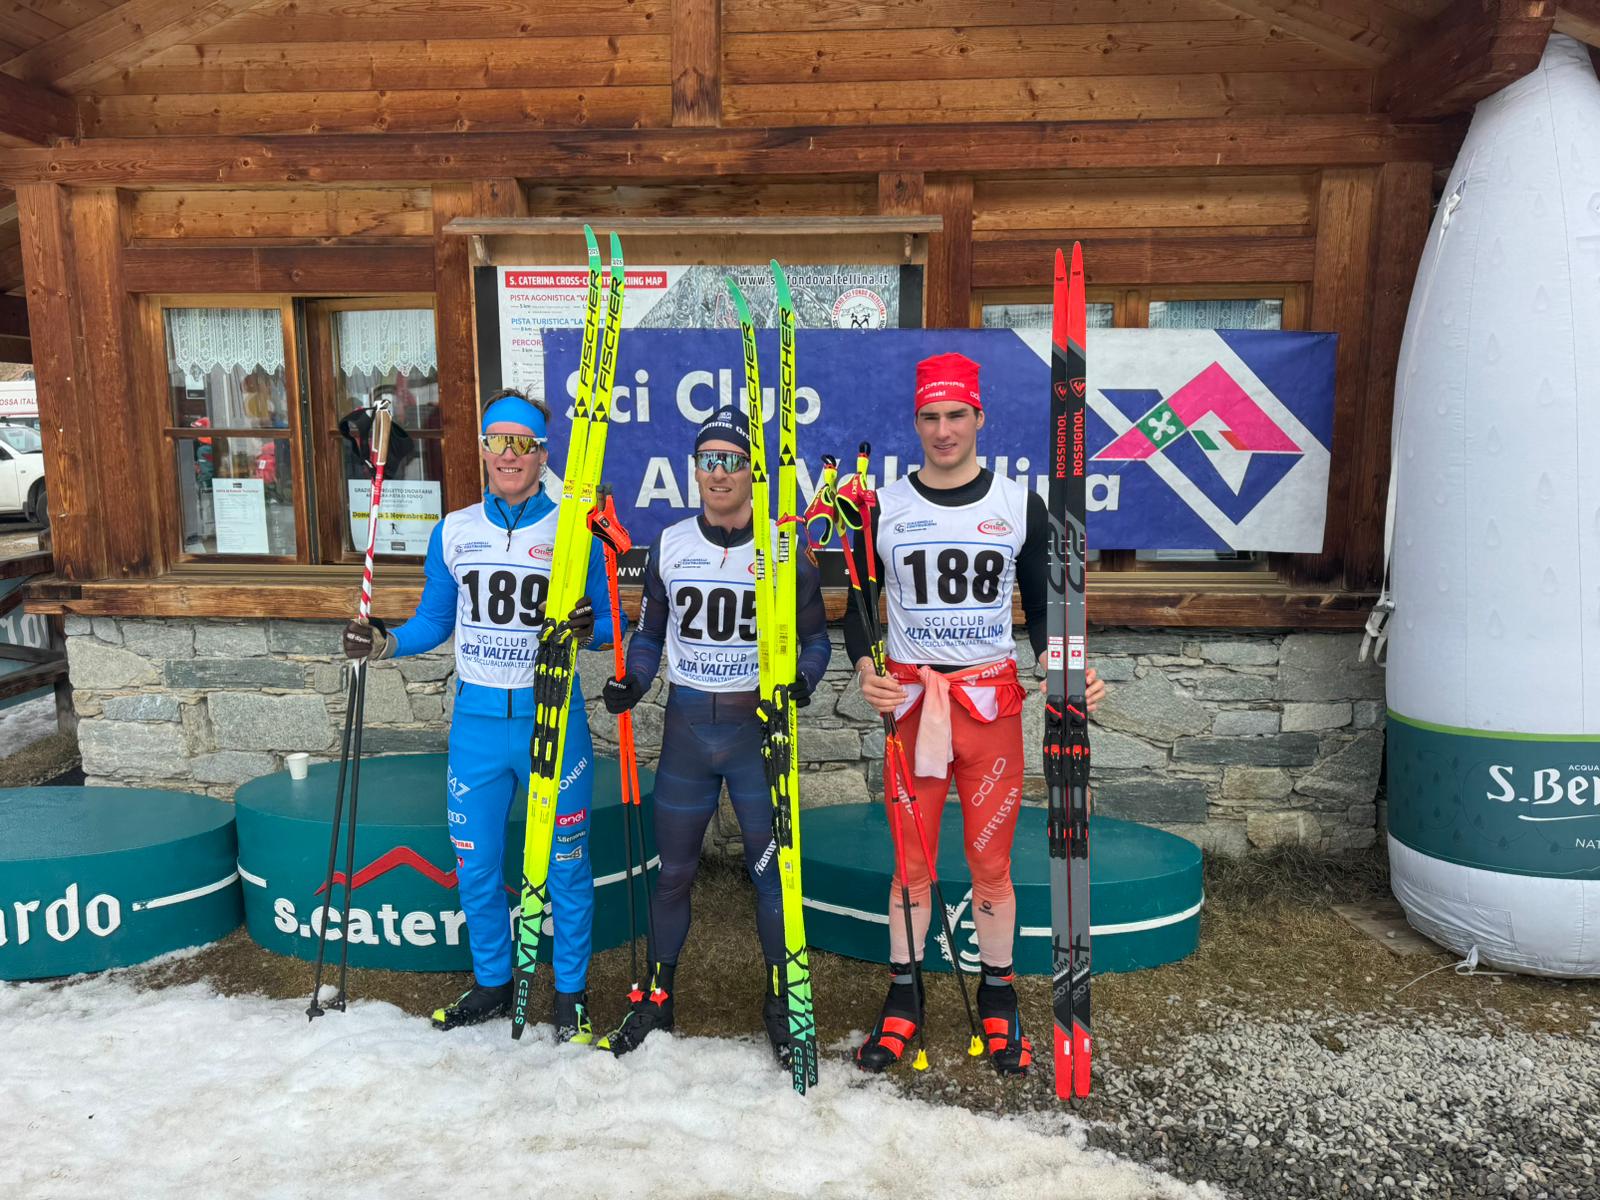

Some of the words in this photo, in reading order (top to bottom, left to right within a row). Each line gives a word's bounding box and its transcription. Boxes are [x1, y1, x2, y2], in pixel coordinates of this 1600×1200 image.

[510, 294, 529, 302] PISTA
[531, 294, 576, 302] AGONISTICA
[518, 275, 554, 286] CATERINA
[646, 276, 663, 286] MAP
[739, 275, 889, 286] www.sfondovaltellina.it
[511, 318, 530, 326] PISTA
[533, 317, 569, 326] TURISTICA
[580, 270, 600, 387] FISCHER
[600, 277, 622, 393] FISCHER
[742, 321, 760, 450] FISCHER
[781, 307, 792, 434] FISCHER
[1056, 410, 1068, 479] ROSSIGNOL
[1073, 407, 1084, 477] ROSSIGNOL
[461, 569, 550, 627] 189
[903, 548, 1005, 605] 188
[676, 586, 758, 643] 205
[905, 626, 931, 640] ALTA
[935, 624, 1004, 640] VALTELLINA
[925, 616, 945, 627] SCI
[950, 616, 984, 627] CLUB
[460, 643, 480, 657] ALTA
[476, 634, 492, 645] SCI
[495, 636, 528, 648] CLUB
[693, 652, 711, 661] SCI
[715, 653, 747, 662] CLUB
[676, 658, 698, 673] ALTA
[557, 757, 588, 794] ONERI
[971, 757, 1007, 807] odlo
[559, 810, 584, 825] enel
[973, 787, 1019, 853] RAIFFEISEN
[515, 979, 529, 1026] SPEED
[793, 1046, 804, 1094] SPEED
[804, 1041, 817, 1084] SPEED
